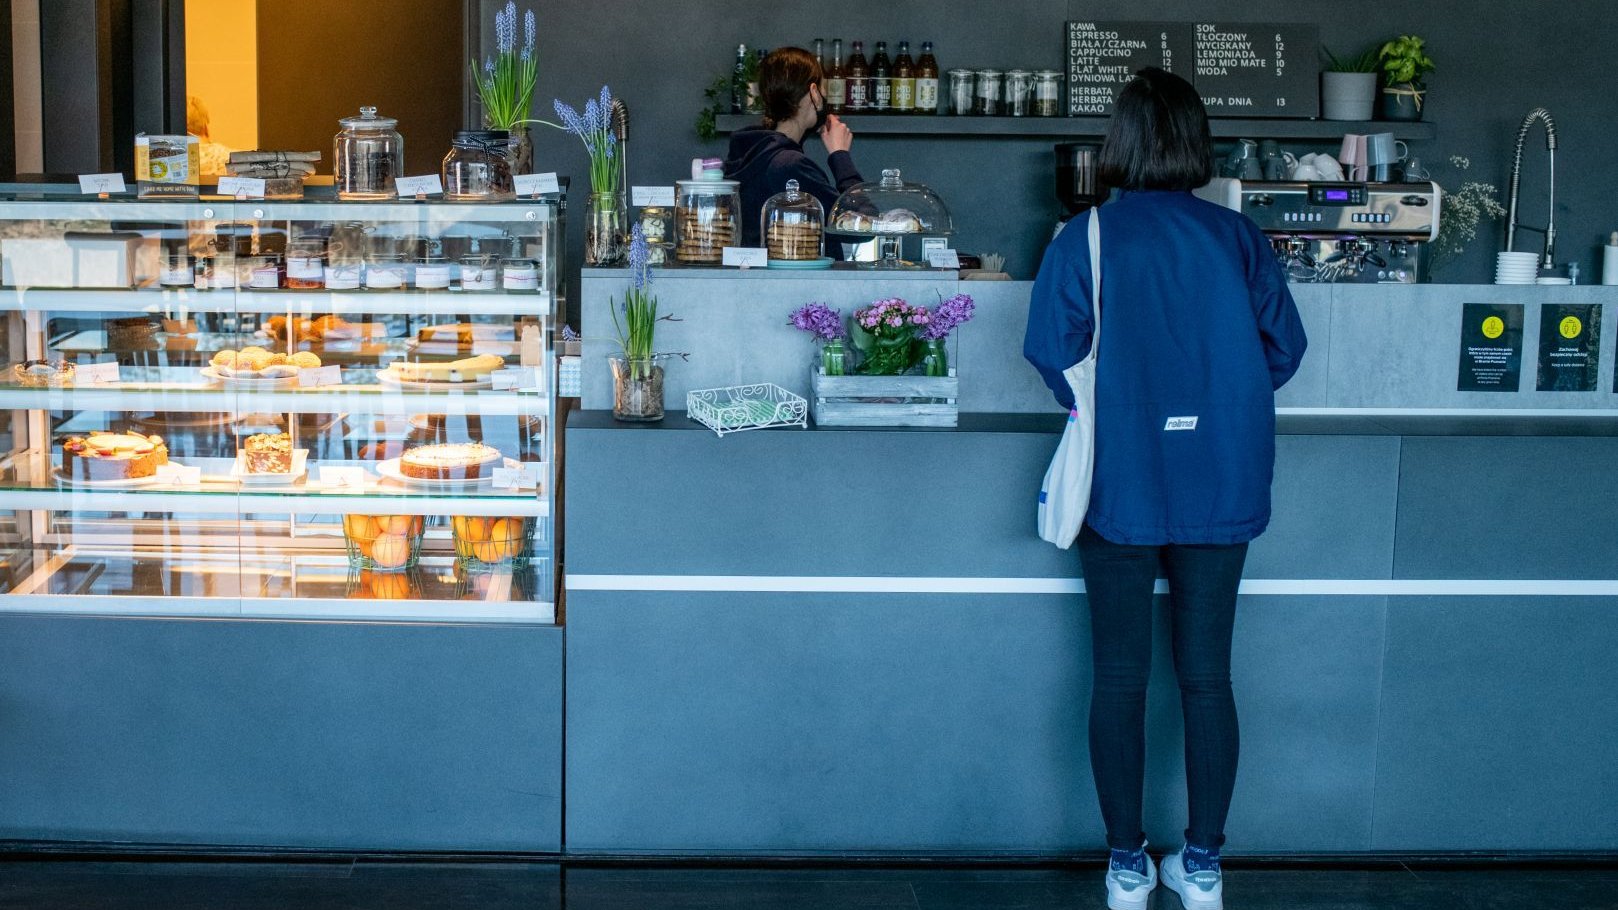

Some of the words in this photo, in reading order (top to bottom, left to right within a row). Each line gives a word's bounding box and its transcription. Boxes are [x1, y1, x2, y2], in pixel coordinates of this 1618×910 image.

[1197, 24, 1216, 32] SOK
[1070, 32, 1118, 40] ESPRESSO
[1161, 32, 1167, 40] 6
[1197, 33, 1247, 42] TŁOCZONY
[1276, 34, 1282, 42] 6
[1161, 41, 1167, 49] 8
[1196, 42, 1252, 50] WYCISKANY
[1276, 42, 1284, 51] 12
[1070, 49, 1132, 57] CAPPUCCINO
[1163, 50, 1172, 58] 10
[1197, 50, 1256, 58] LEMONIADA
[1276, 51, 1282, 59] 9
[1071, 57, 1100, 65] LATTE
[1163, 58, 1172, 66] 12
[1198, 59, 1216, 67] MIO
[1220, 59, 1238, 67] MIO
[1241, 59, 1266, 68] MATE
[1276, 60, 1285, 68] 10
[1071, 66, 1094, 74] FLAT
[1098, 66, 1129, 74] WHITE
[1197, 67, 1228, 76] WODA
[1276, 68, 1282, 76] 5
[851, 85, 866, 93] MIO
[1071, 87, 1113, 96] HERBATA
[1071, 96, 1113, 104] HERBATA
[1229, 98, 1252, 106] DNIA
[1277, 98, 1286, 107] 13
[1072, 105, 1105, 113] KAKAO
